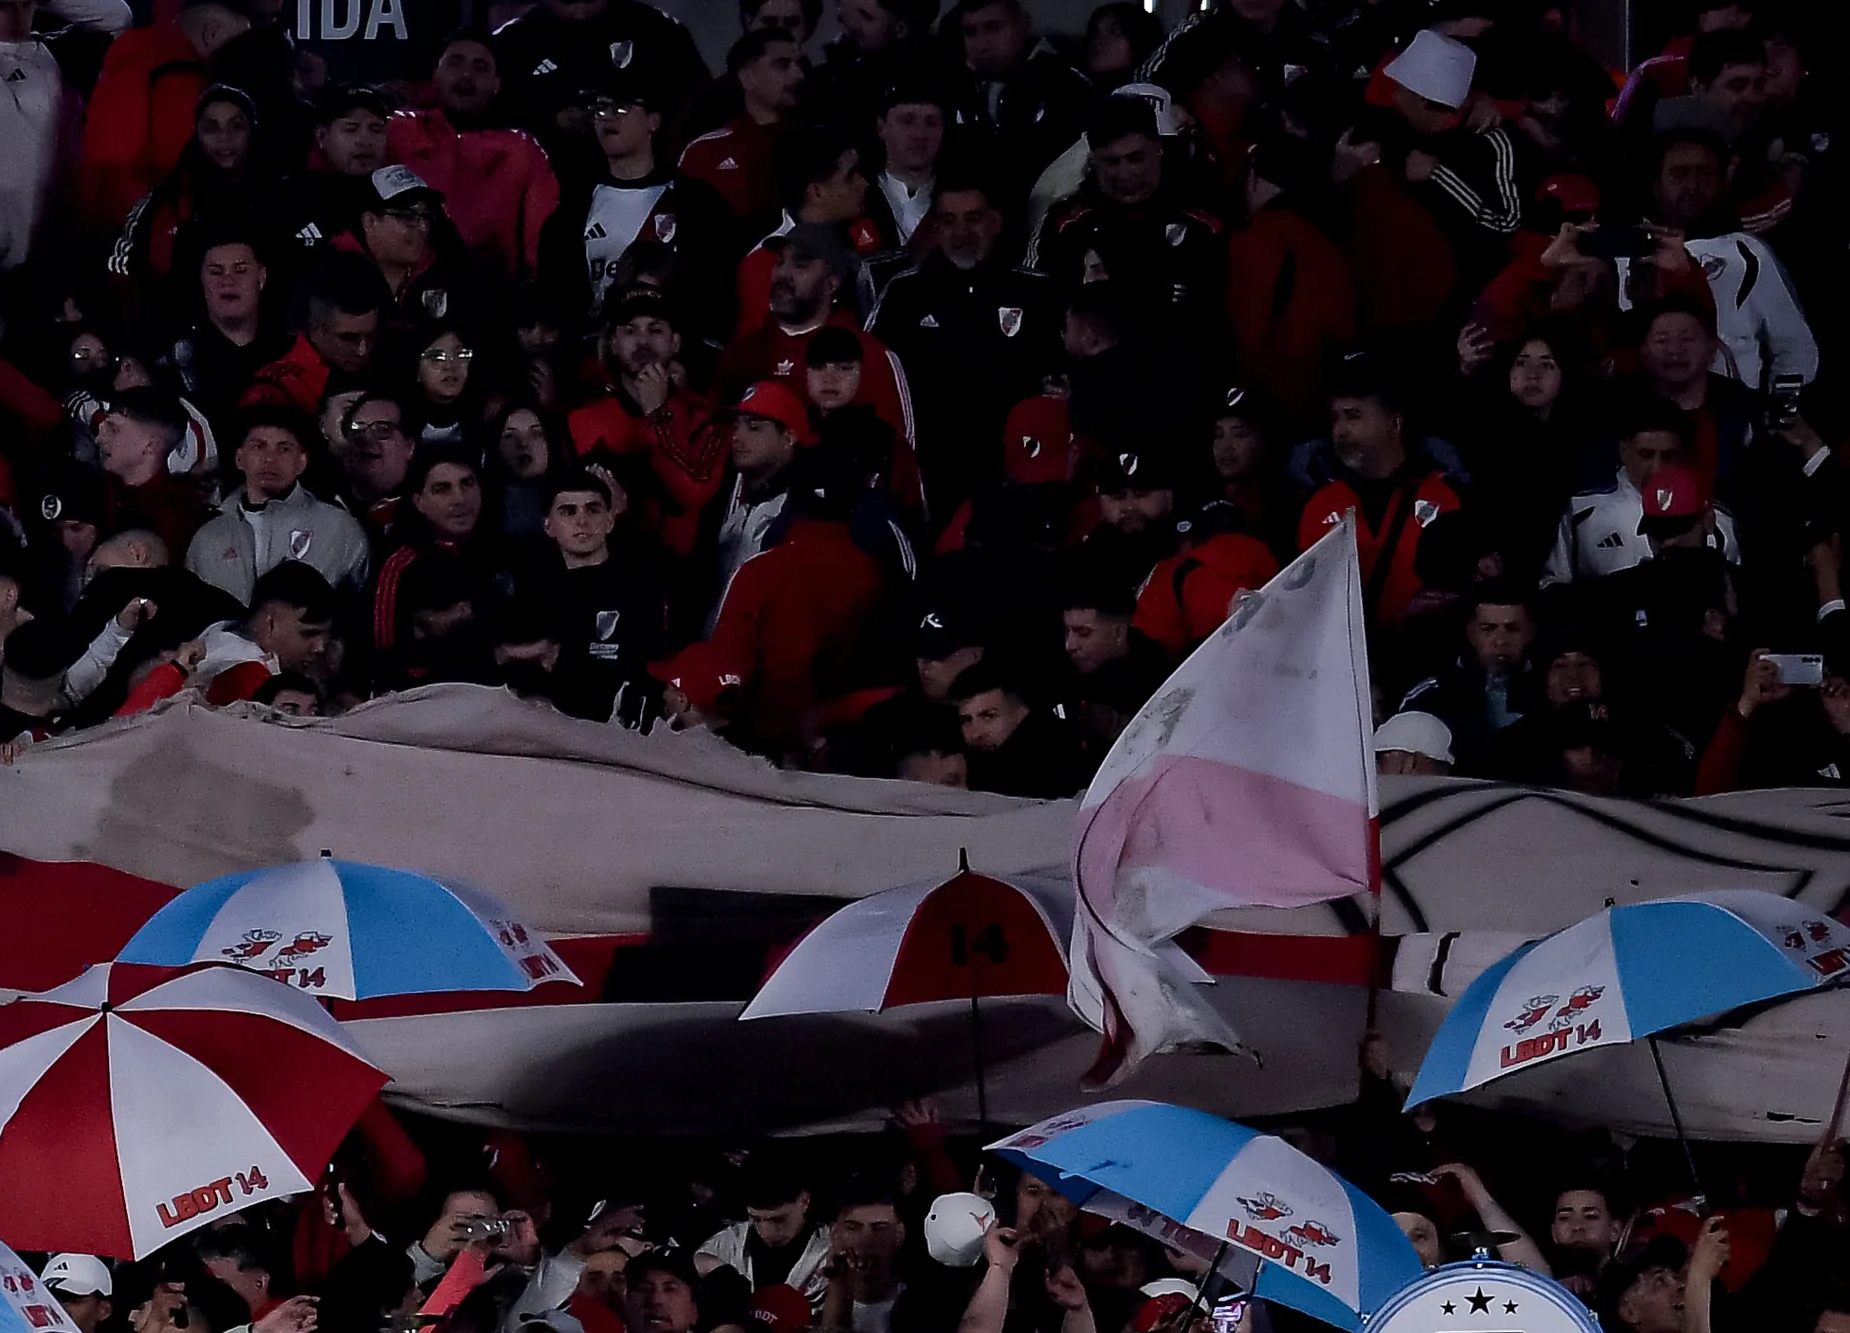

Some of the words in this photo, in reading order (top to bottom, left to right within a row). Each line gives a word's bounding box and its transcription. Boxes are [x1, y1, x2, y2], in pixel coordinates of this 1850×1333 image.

[951, 922, 1010, 965] 14
[298, 966, 326, 989] 14
[1500, 1027, 1575, 1070] LBDT
[1575, 1017, 1603, 1045] 14
[155, 1176, 235, 1230] LBDT
[235, 1165, 269, 1197] 14
[1227, 1217, 1305, 1269] LBDT
[1305, 1255, 1333, 1285] 14
